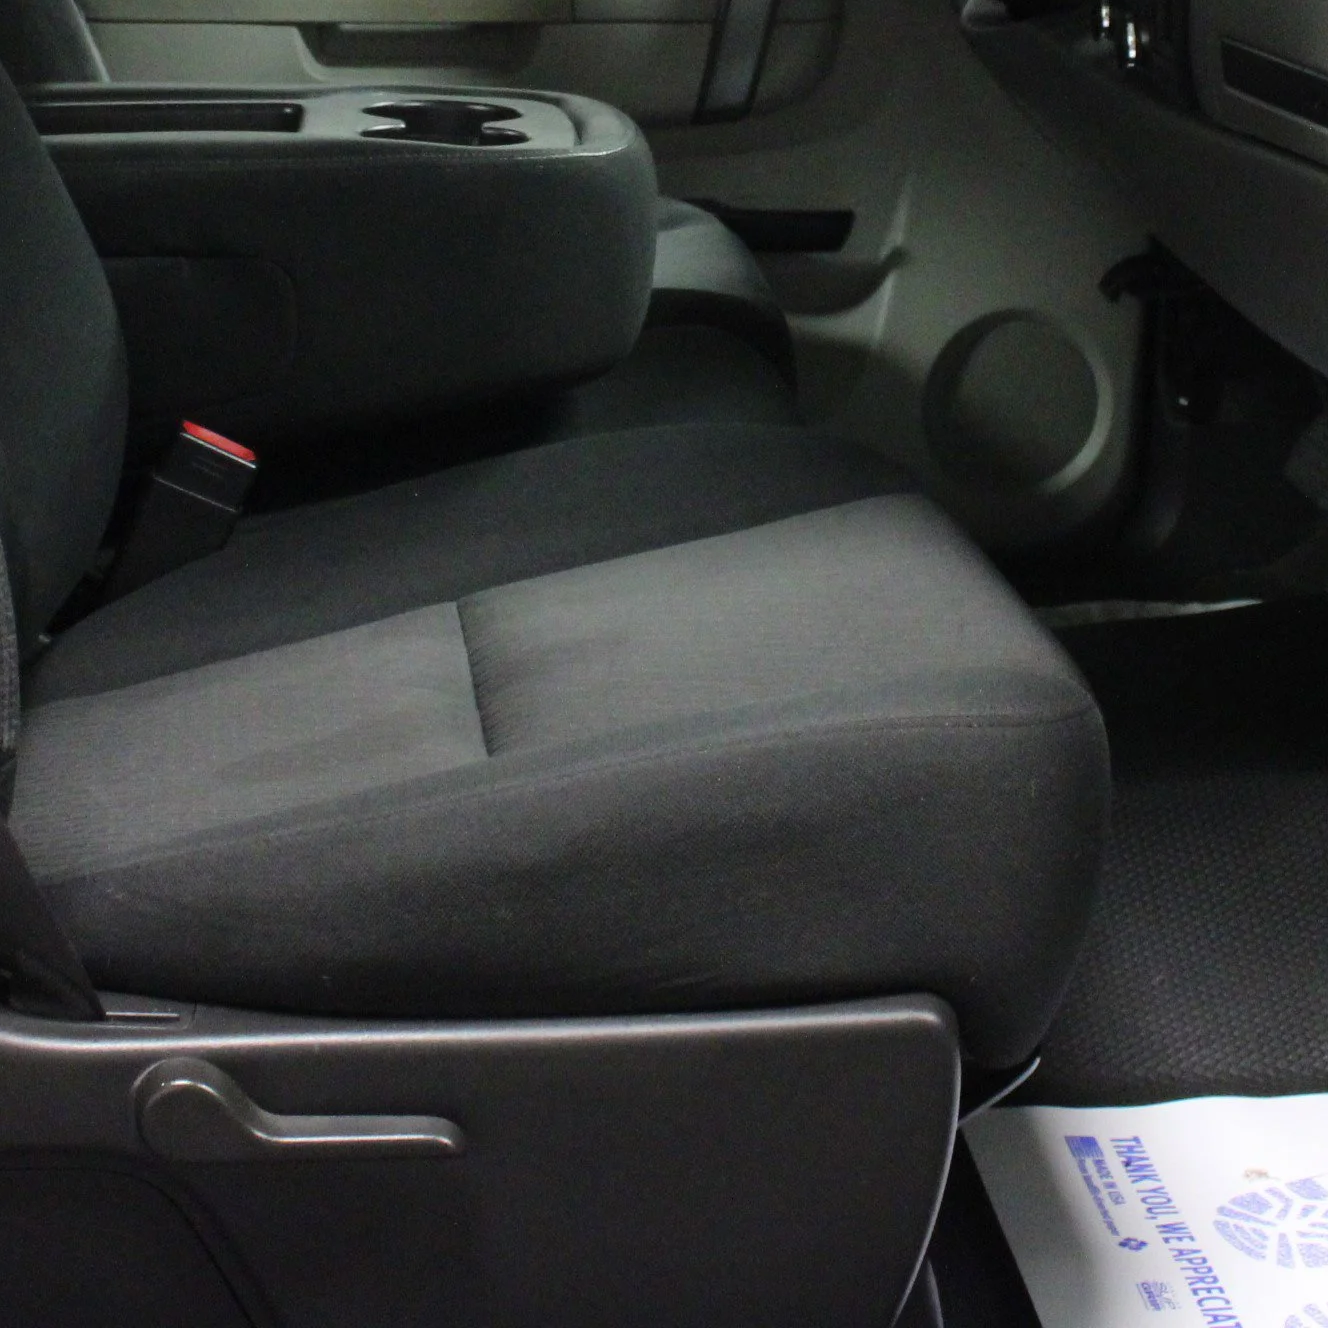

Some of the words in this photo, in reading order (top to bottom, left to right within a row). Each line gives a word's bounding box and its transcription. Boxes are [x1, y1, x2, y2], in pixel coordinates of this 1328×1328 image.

[1110, 1135, 1162, 1184] THANK
[1108, 1190, 1127, 1205] USA
[1135, 1185, 1180, 1220] YOU,
[1156, 1221, 1196, 1244] WE
